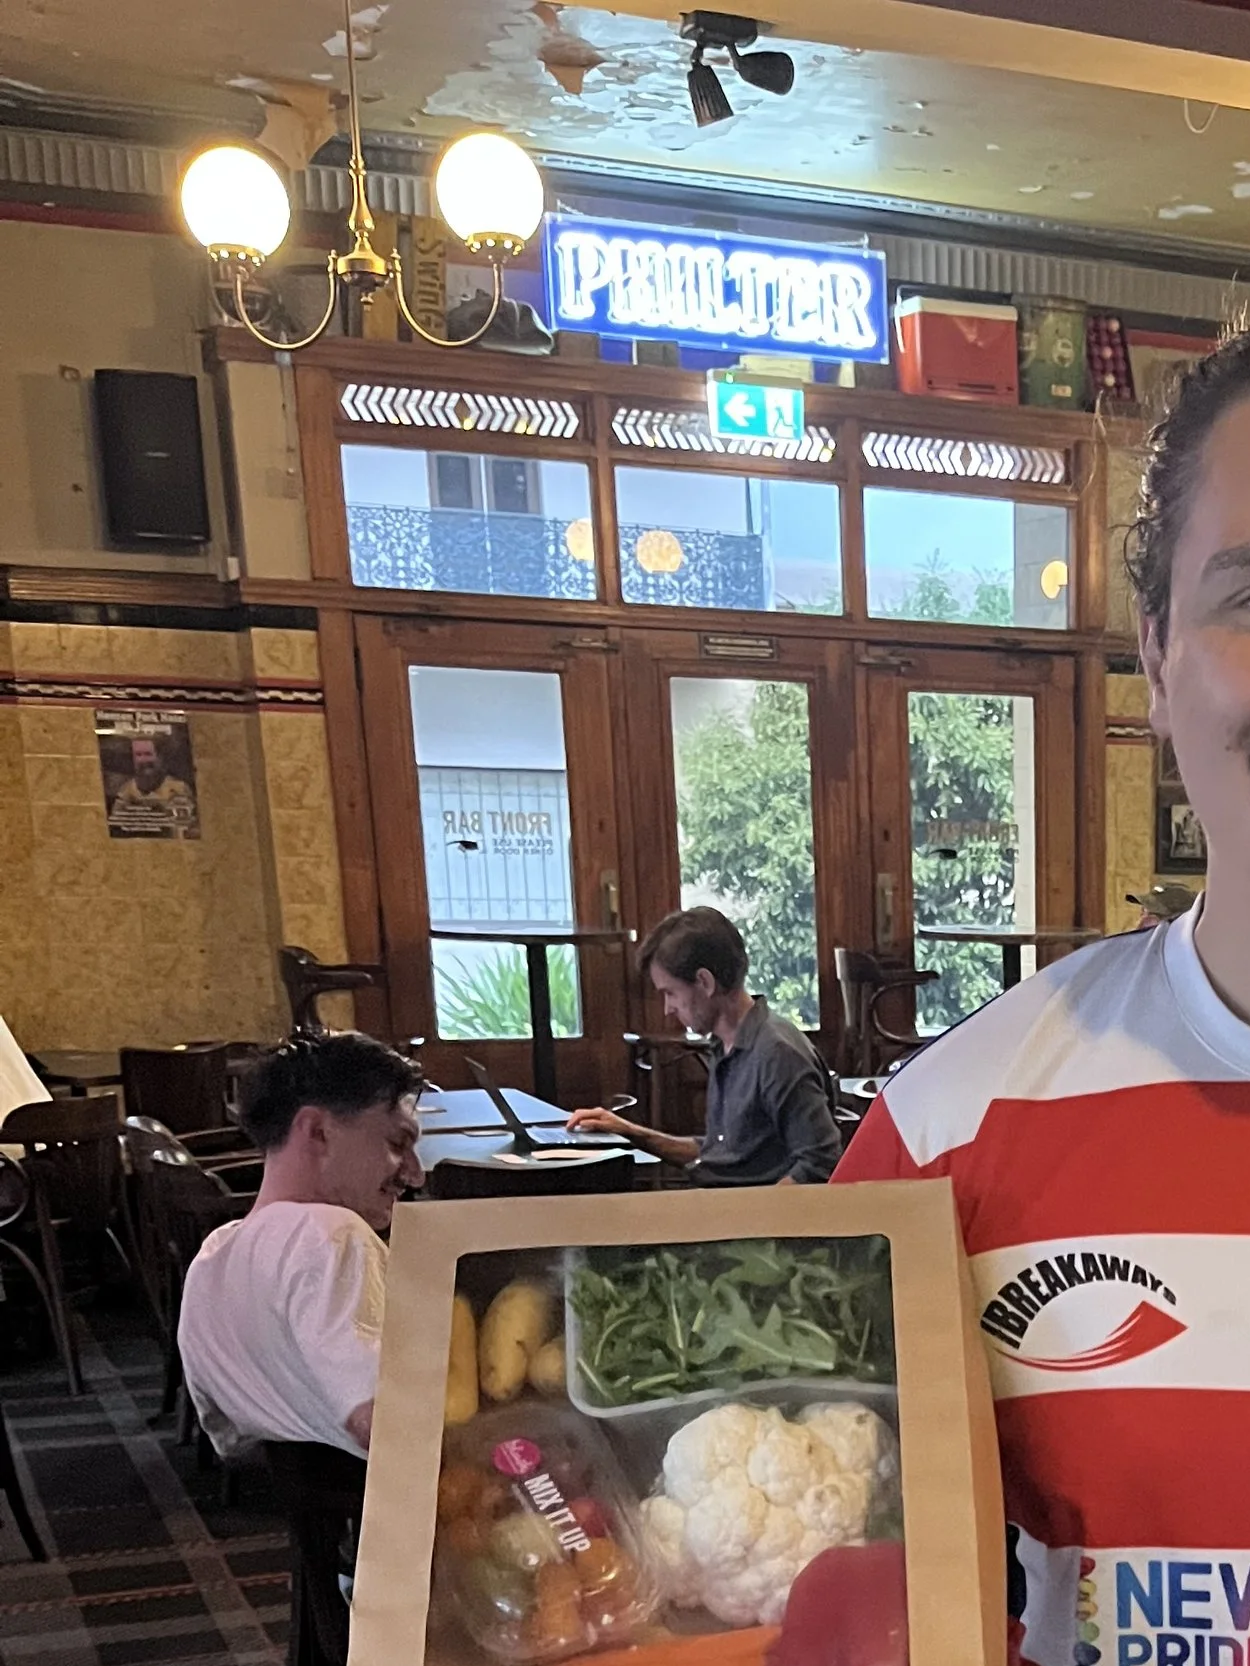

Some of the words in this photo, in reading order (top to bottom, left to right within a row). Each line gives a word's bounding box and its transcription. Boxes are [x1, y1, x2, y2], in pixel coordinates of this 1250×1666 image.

[555, 232, 877, 349] PHILTER
[524, 1473, 564, 1511] MIX
[545, 1507, 576, 1528] IT
[558, 1527, 591, 1552] UP
